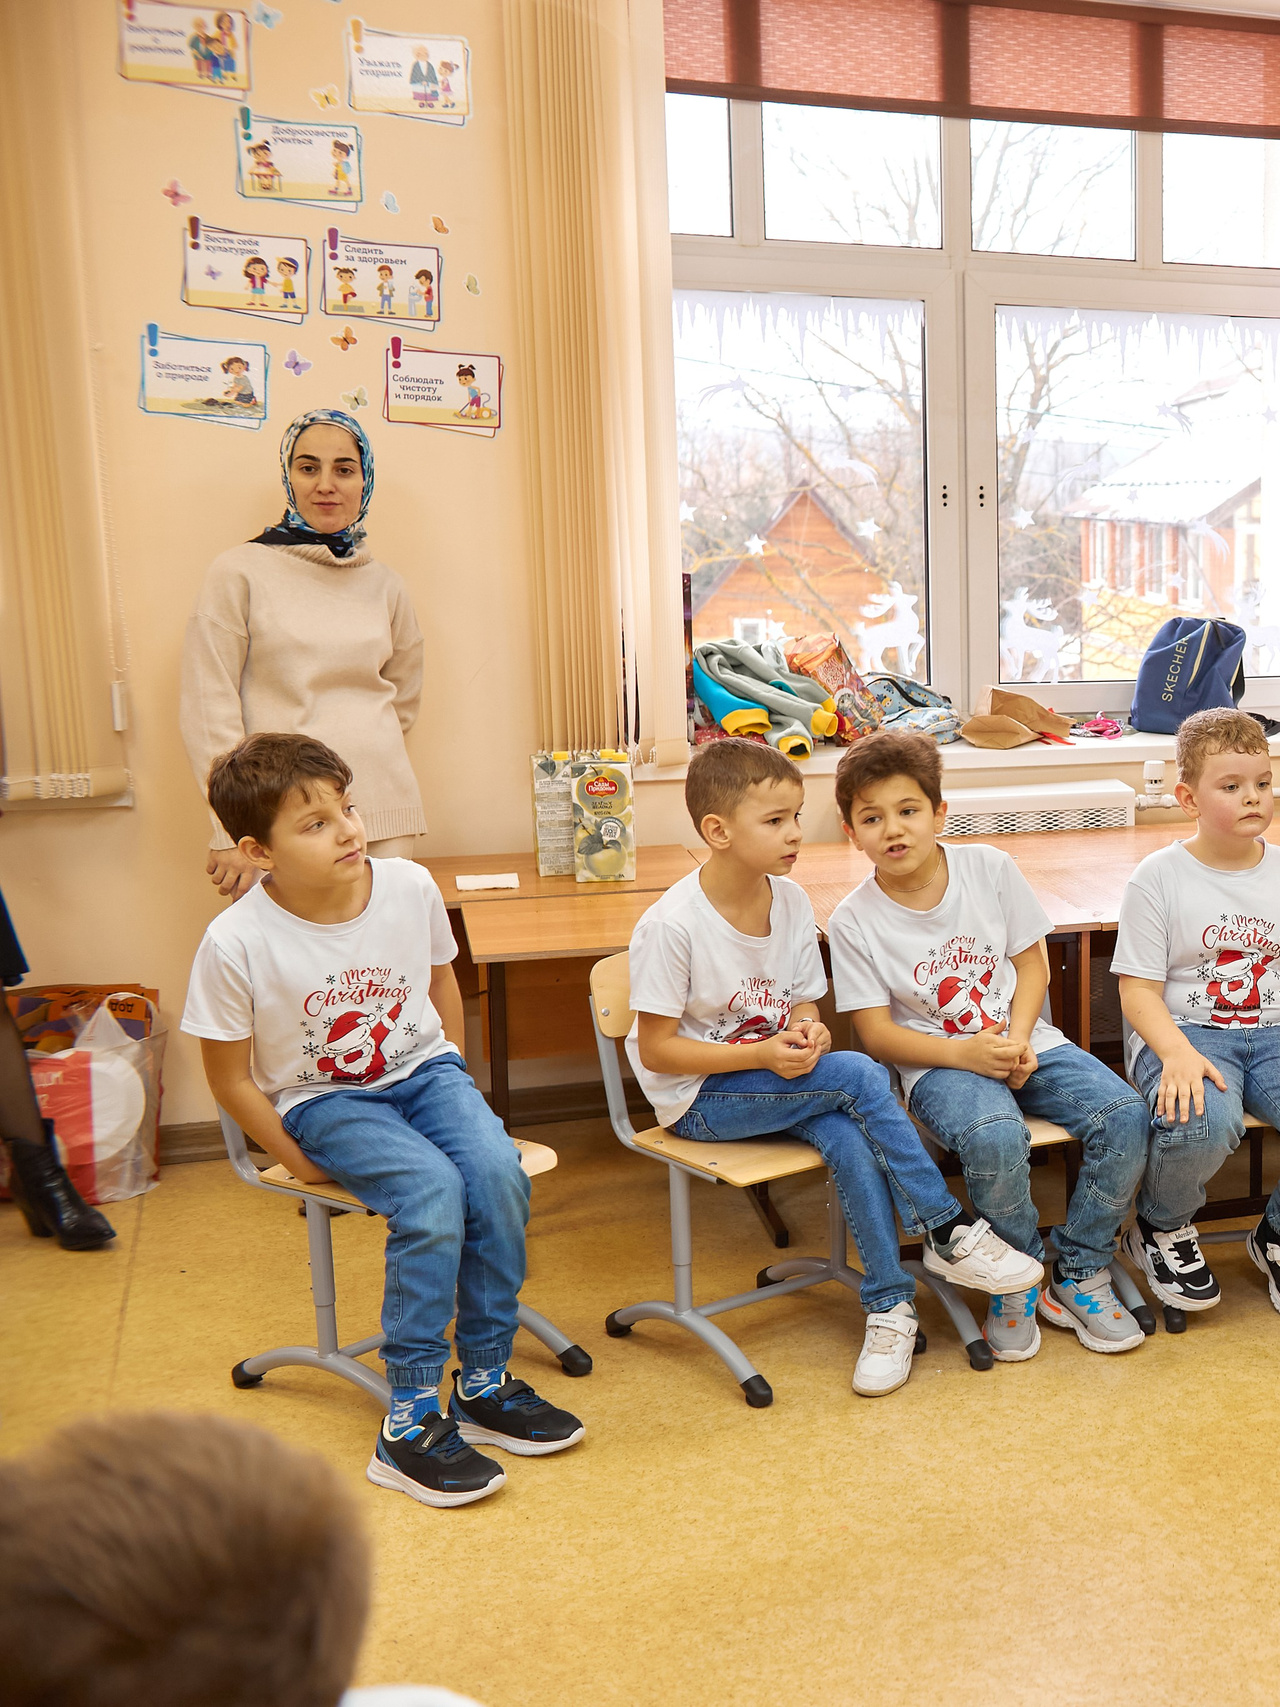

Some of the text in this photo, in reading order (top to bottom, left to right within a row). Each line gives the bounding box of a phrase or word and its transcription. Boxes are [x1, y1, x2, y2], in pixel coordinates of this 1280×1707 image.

[203, 233, 260, 247] Вести себя
[204, 244, 260, 257] культурно
[344, 244, 384, 255] Следить
[356, 256, 408, 265] здоровьем
[152, 360, 213, 373] Заботиться
[164, 372, 209, 382] природе
[392, 373, 445, 385] Соблюдать
[399, 384, 438, 395] чистоту
[403, 393, 443, 402] порядок
[1231, 913, 1276, 936] Merry
[939, 934, 977, 957] Merry
[913, 946, 1000, 986] Christmas
[339, 966, 392, 988] Merry
[303, 979, 412, 1018] Christmas
